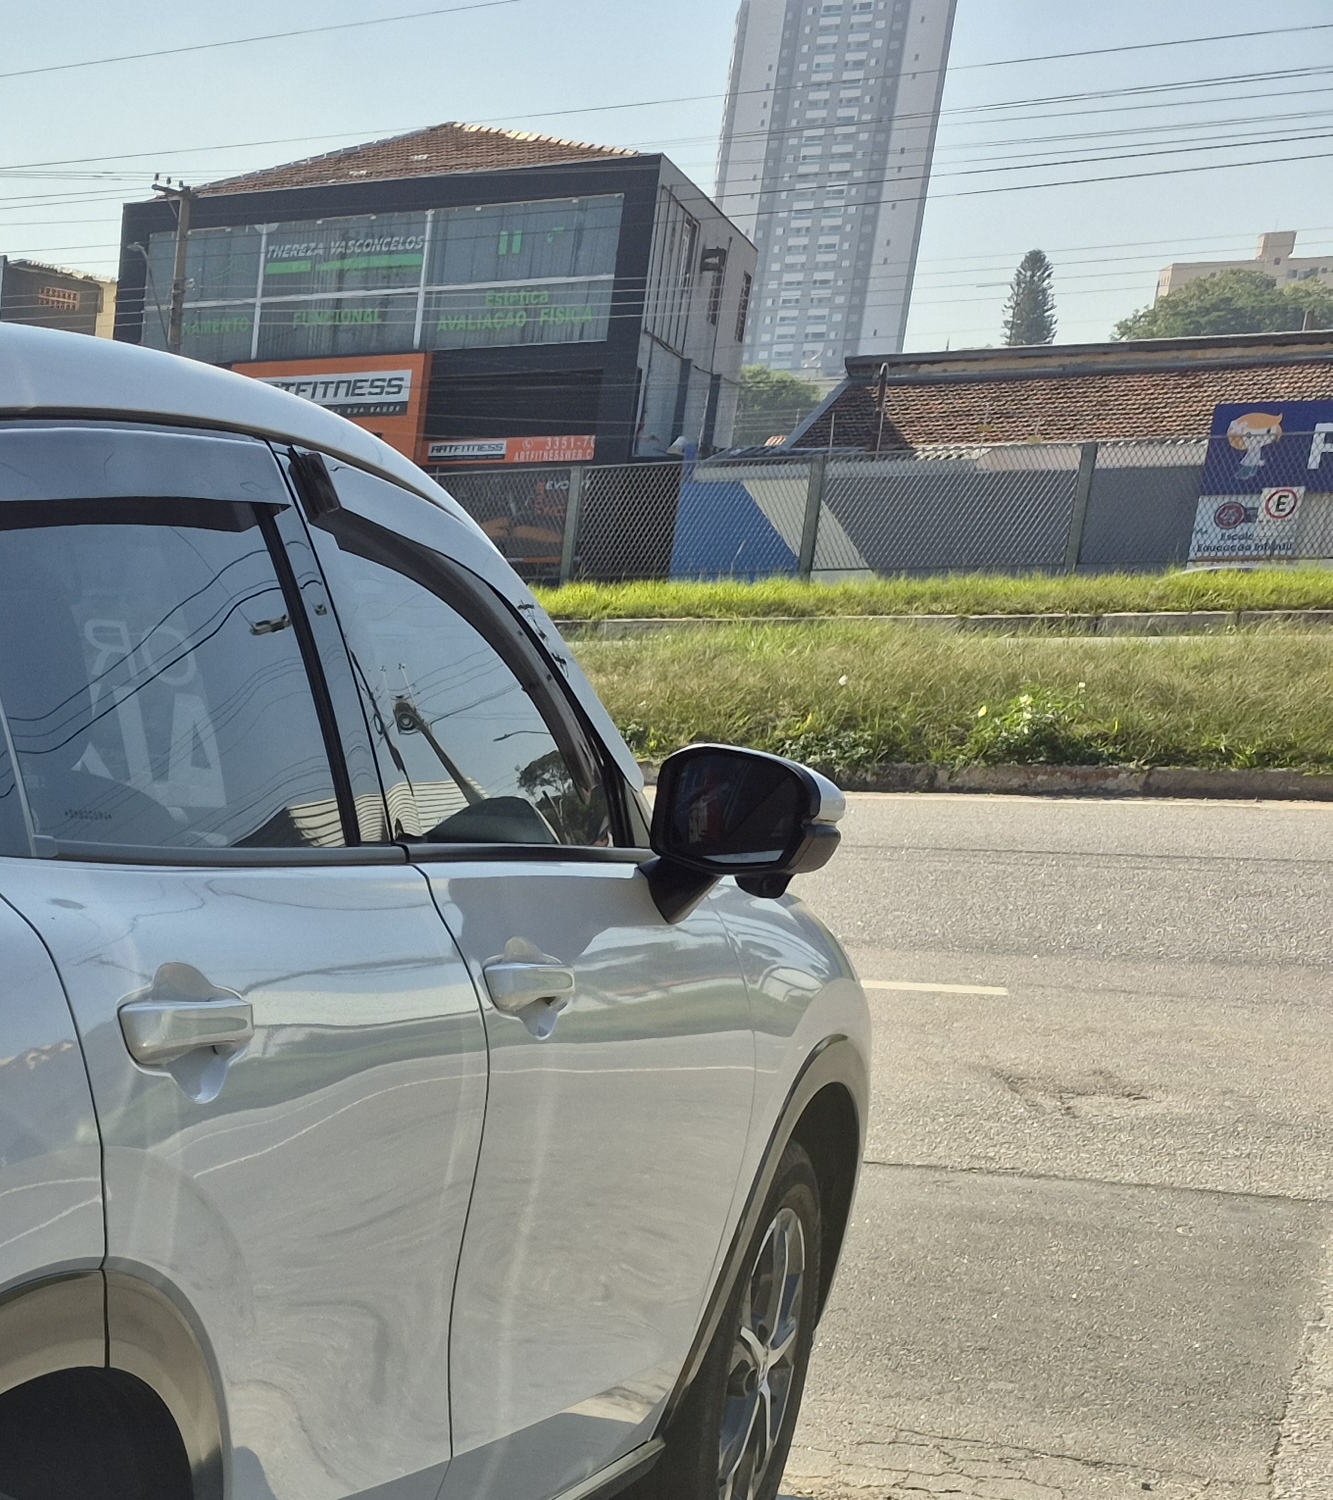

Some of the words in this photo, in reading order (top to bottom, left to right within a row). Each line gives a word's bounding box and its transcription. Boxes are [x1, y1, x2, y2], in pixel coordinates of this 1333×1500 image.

[267, 241, 324, 259] THEREZA
[330, 235, 425, 255] VASCONCELOS
[1275, 494, 1290, 512] E
